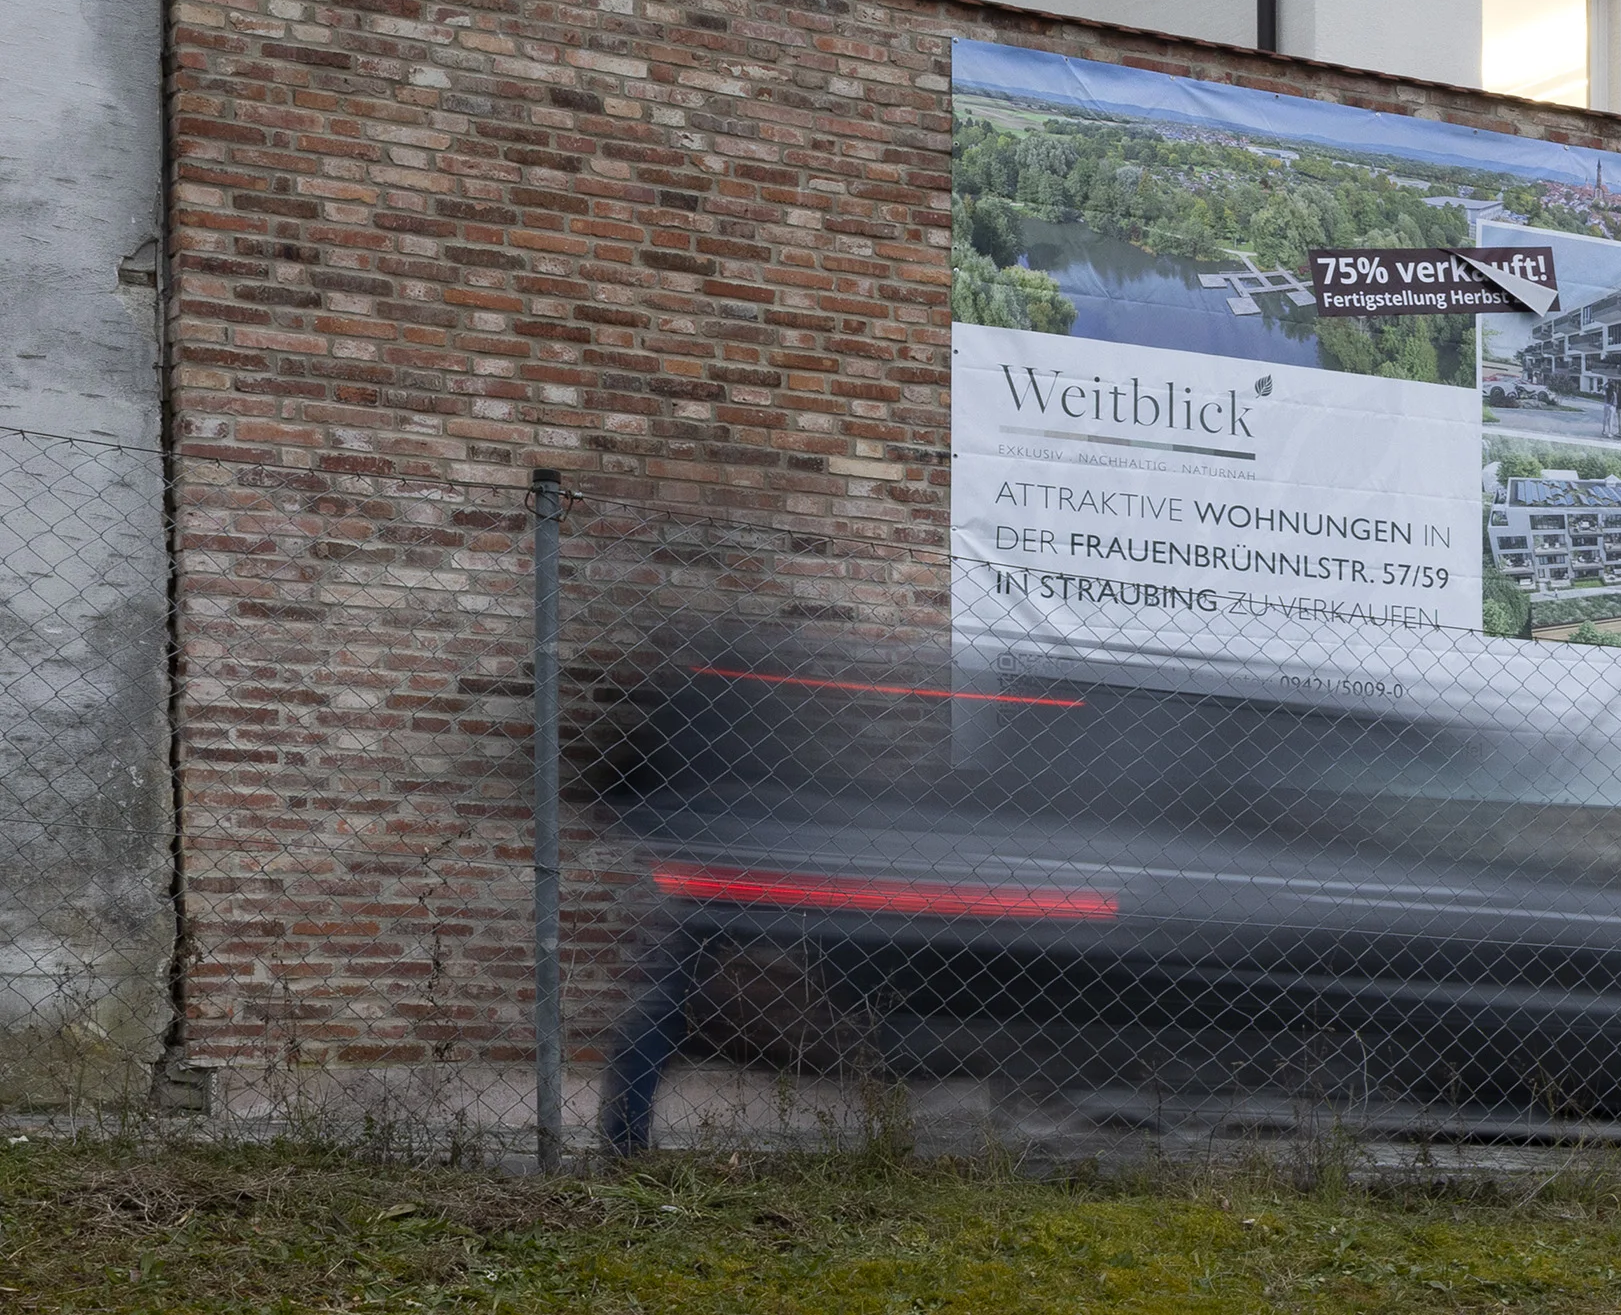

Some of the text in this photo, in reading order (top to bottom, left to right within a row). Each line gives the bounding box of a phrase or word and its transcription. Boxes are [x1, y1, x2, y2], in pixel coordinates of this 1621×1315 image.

[1317, 257, 1389, 285] 75%
[1323, 290, 1447, 311] Fertigstellung
[1450, 289, 1508, 306] Herbst
[998, 364, 1255, 438] Weitblick
[998, 444, 1256, 481] EXKLUSIV NACHHALTIG NATURNAH
[995, 481, 1450, 548] ATTRAKTIVE WOHNUNGEN IN
[996, 526, 1449, 589] DER FRAUENBRÜNNLSTR. 57/59
[996, 570, 1439, 631] IN STRAUBING ZU VERKAUFEN
